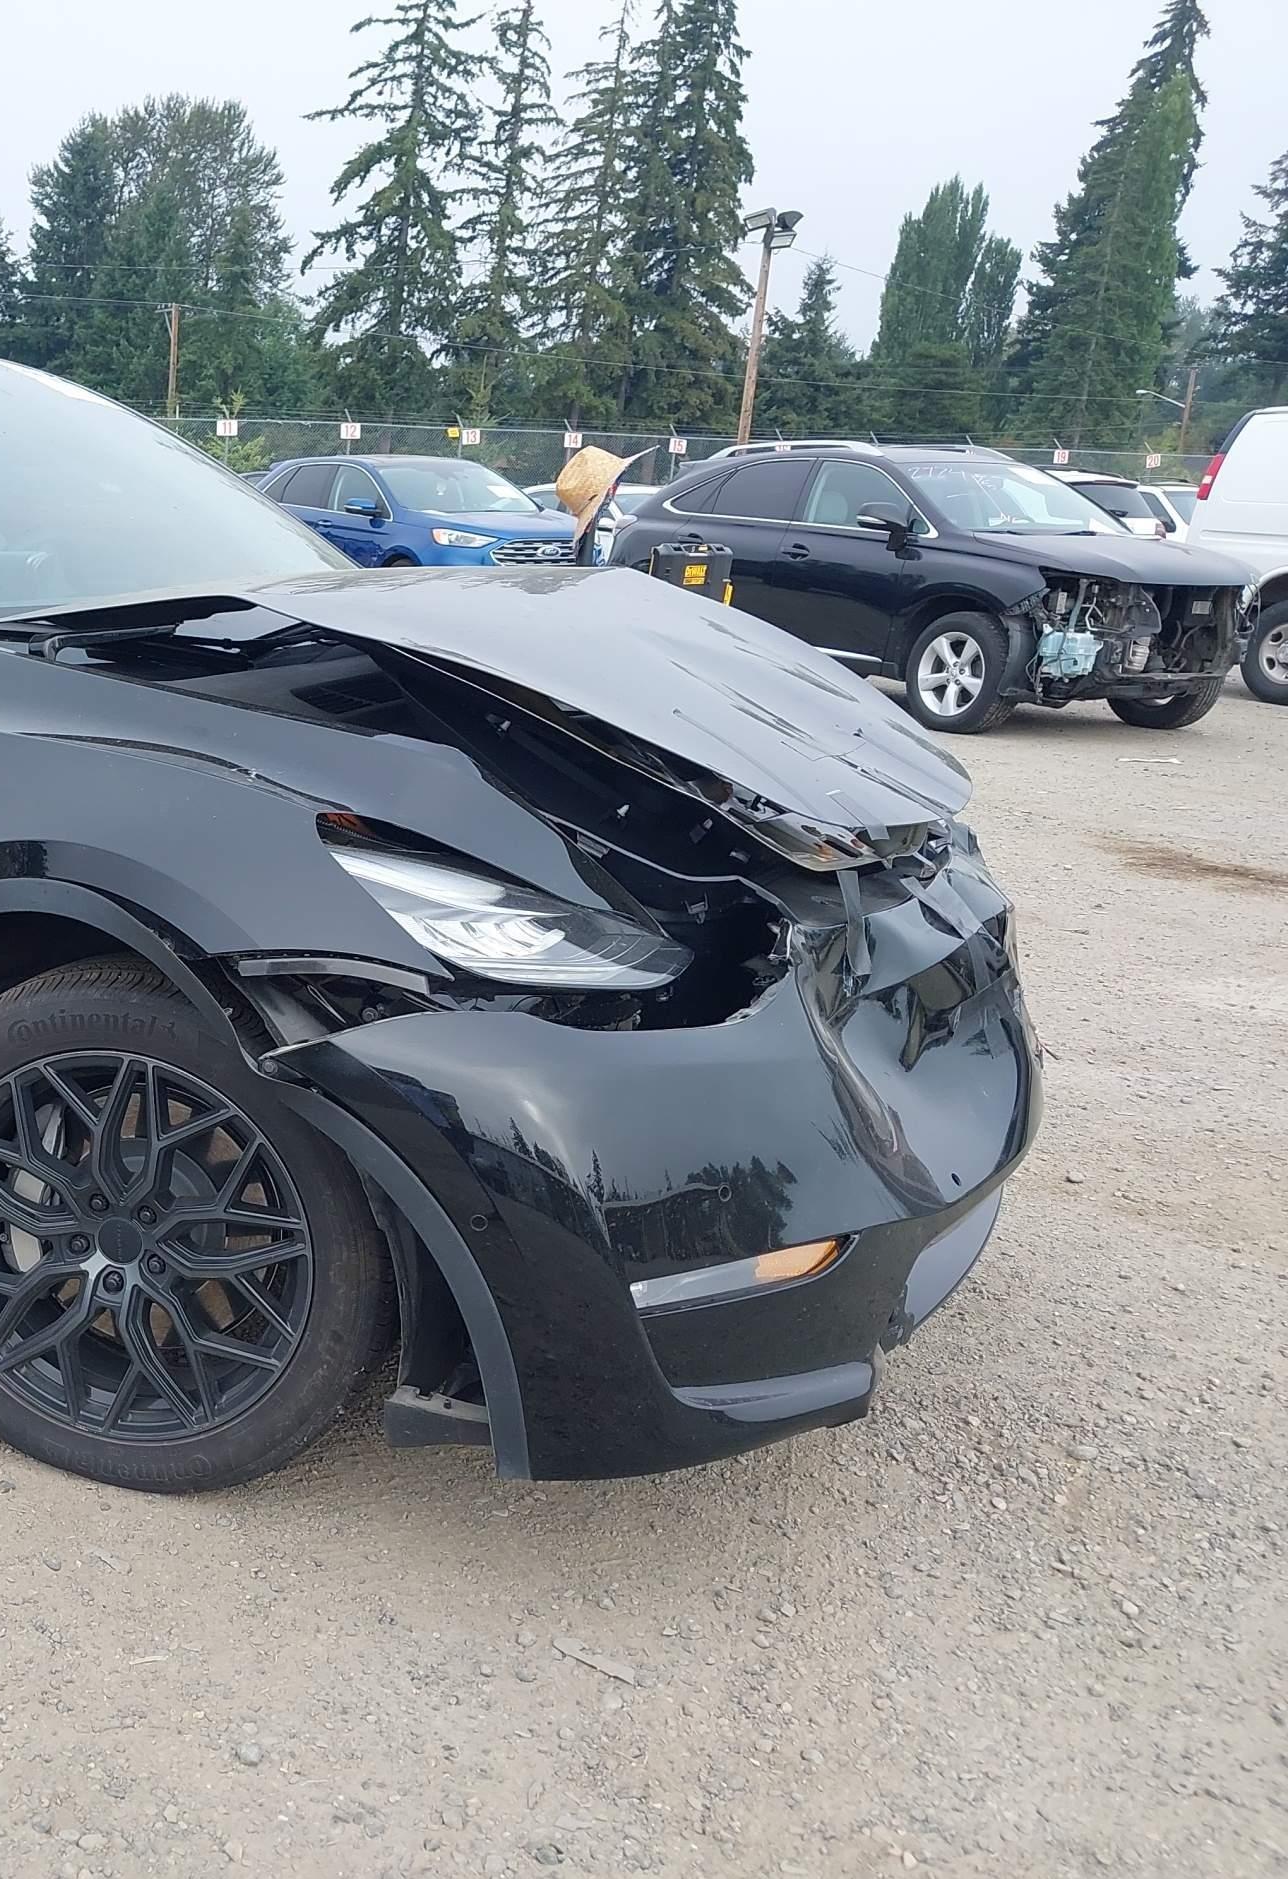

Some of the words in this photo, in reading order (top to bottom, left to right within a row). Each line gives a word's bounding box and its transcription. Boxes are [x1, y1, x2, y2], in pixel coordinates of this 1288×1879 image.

[221, 421, 232, 435] 11
[344, 424, 358, 438] 12
[465, 430, 478, 444] 13
[567, 434, 579, 447] 14
[672, 439, 684, 452] 15
[1056, 451, 1067, 463] 19
[1147, 455, 1159, 467] 20
[7, 1008, 159, 1044] Continental
